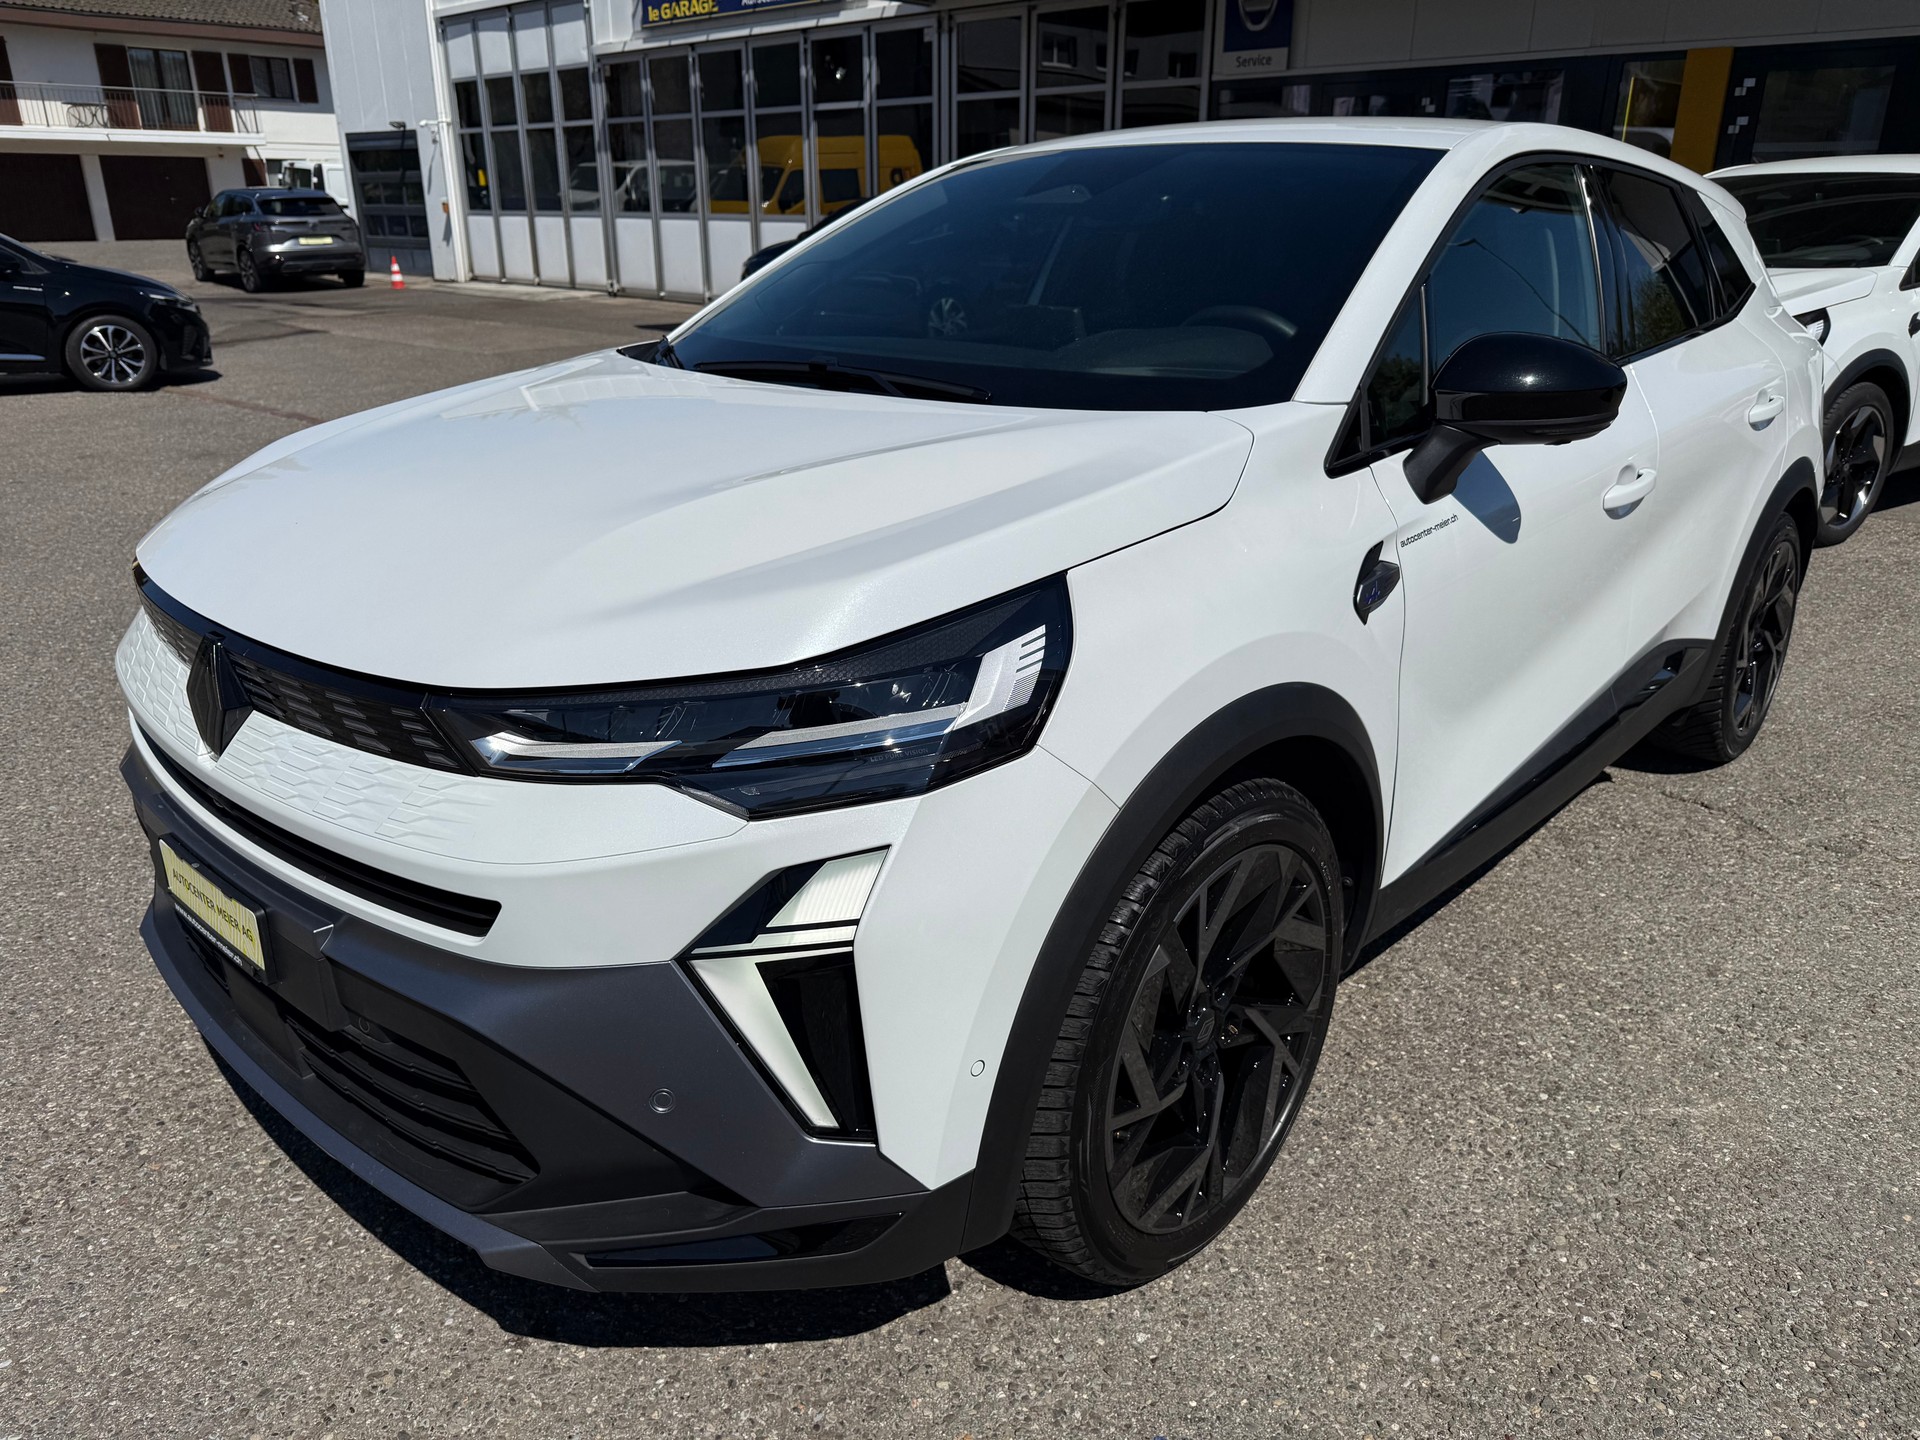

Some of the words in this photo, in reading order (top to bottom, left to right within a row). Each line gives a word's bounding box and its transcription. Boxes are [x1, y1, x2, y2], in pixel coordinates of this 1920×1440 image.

[648, 5, 660, 22] le
[660, 0, 719, 19] GARAGE
[1235, 54, 1273, 68] Service
[1400, 513, 1459, 548] autocenter-meier.ch
[904, 748, 929, 757] VISION
[172, 868, 216, 913] AUTOCENTER
[216, 905, 242, 933] MEIER
[242, 925, 254, 942] AG
[174, 903, 243, 966] www.autocenter-meier.ch
